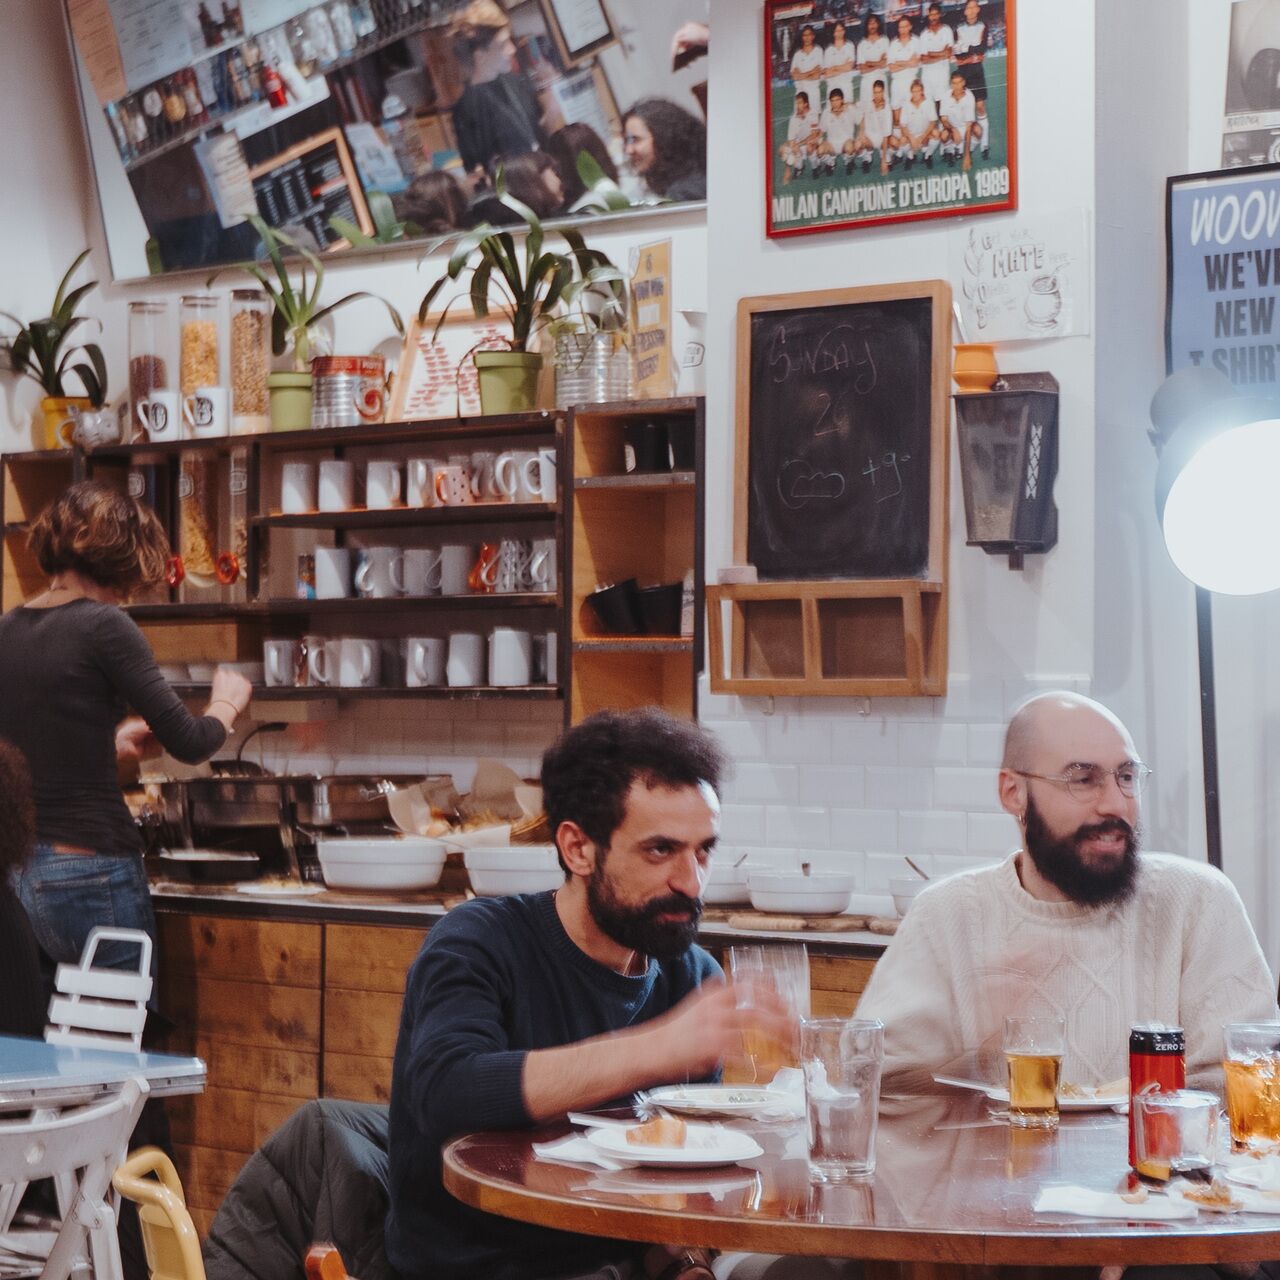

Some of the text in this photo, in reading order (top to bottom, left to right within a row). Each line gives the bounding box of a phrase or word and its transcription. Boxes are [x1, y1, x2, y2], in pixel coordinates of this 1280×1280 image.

[773, 166, 1009, 223] MILAN CAMPIONE D'EUROPA 1989
[1214, 296, 1276, 340] NEW
[1155, 1043, 1178, 1051] ZERO
